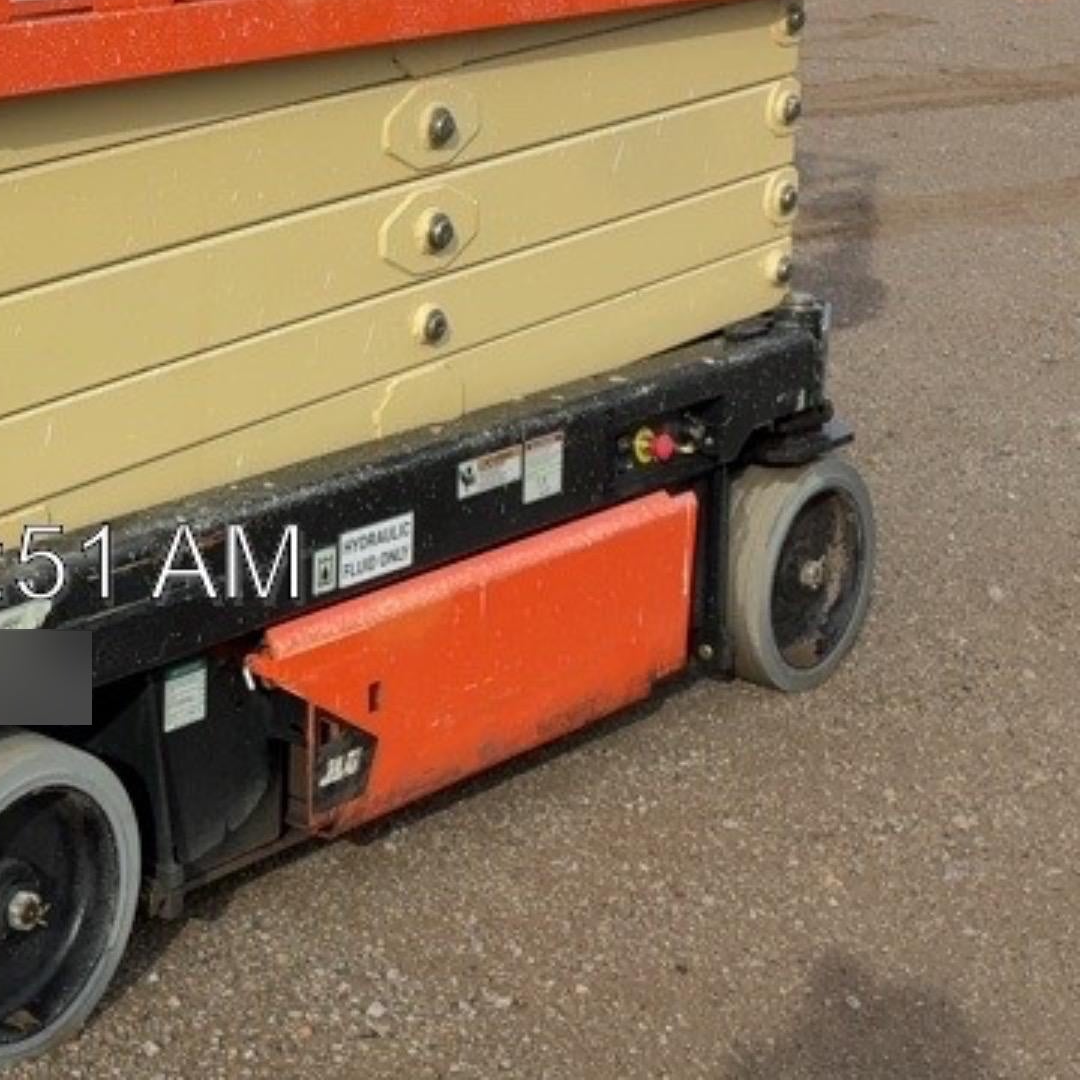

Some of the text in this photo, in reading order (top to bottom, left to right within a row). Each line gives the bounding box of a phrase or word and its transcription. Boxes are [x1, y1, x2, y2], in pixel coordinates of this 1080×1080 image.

[344, 520, 411, 554] HYDRAULIC
[343, 554, 377, 577] FLUID
[380, 545, 409, 568] ONLY
